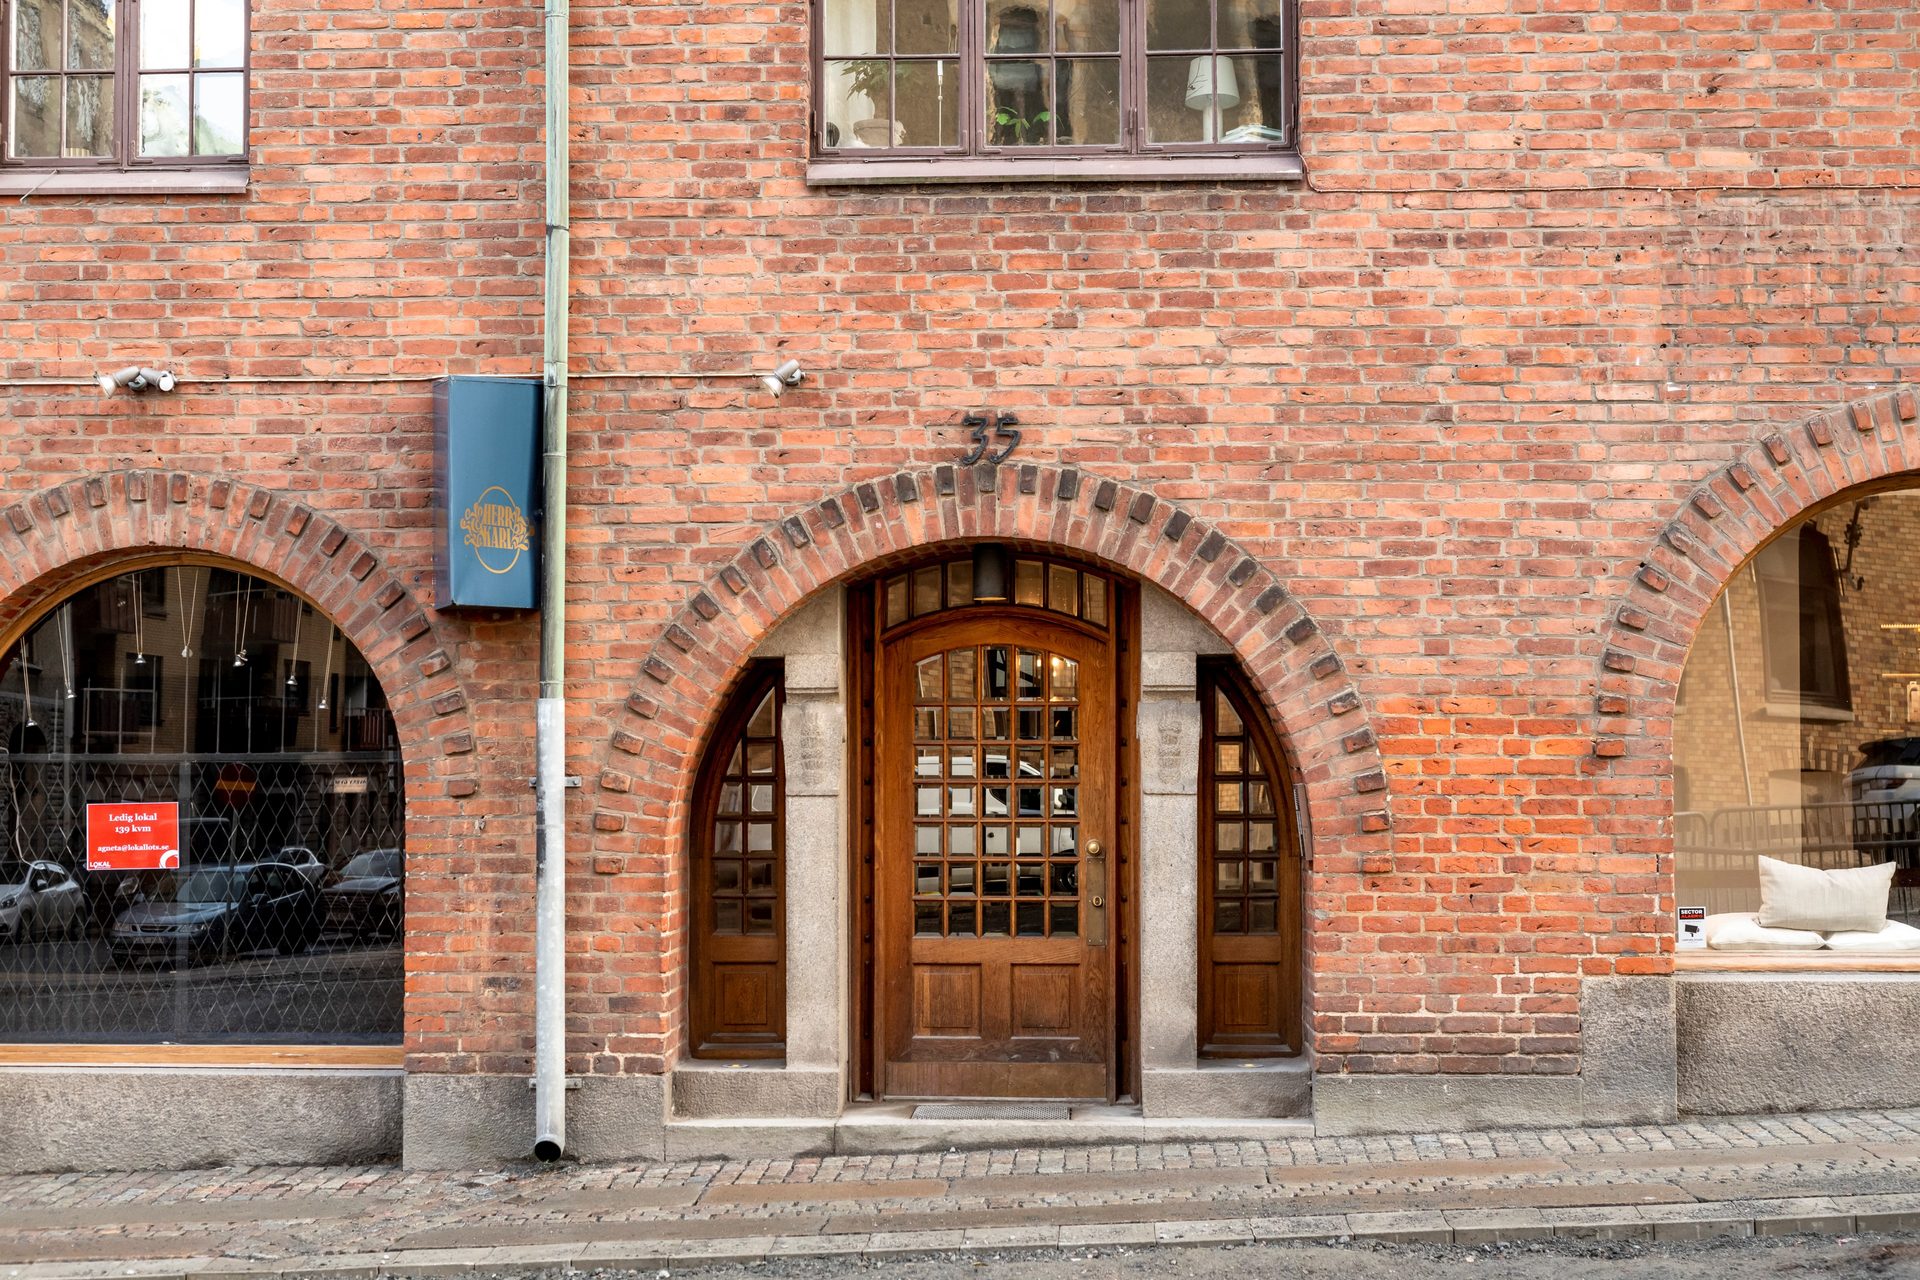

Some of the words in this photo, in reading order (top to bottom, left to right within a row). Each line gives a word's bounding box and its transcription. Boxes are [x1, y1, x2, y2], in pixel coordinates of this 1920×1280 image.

[962, 416, 1021, 464] 35
[109, 813, 133, 822] Ledig
[135, 813, 157, 821] lokal
[115, 826, 130, 834] 139
